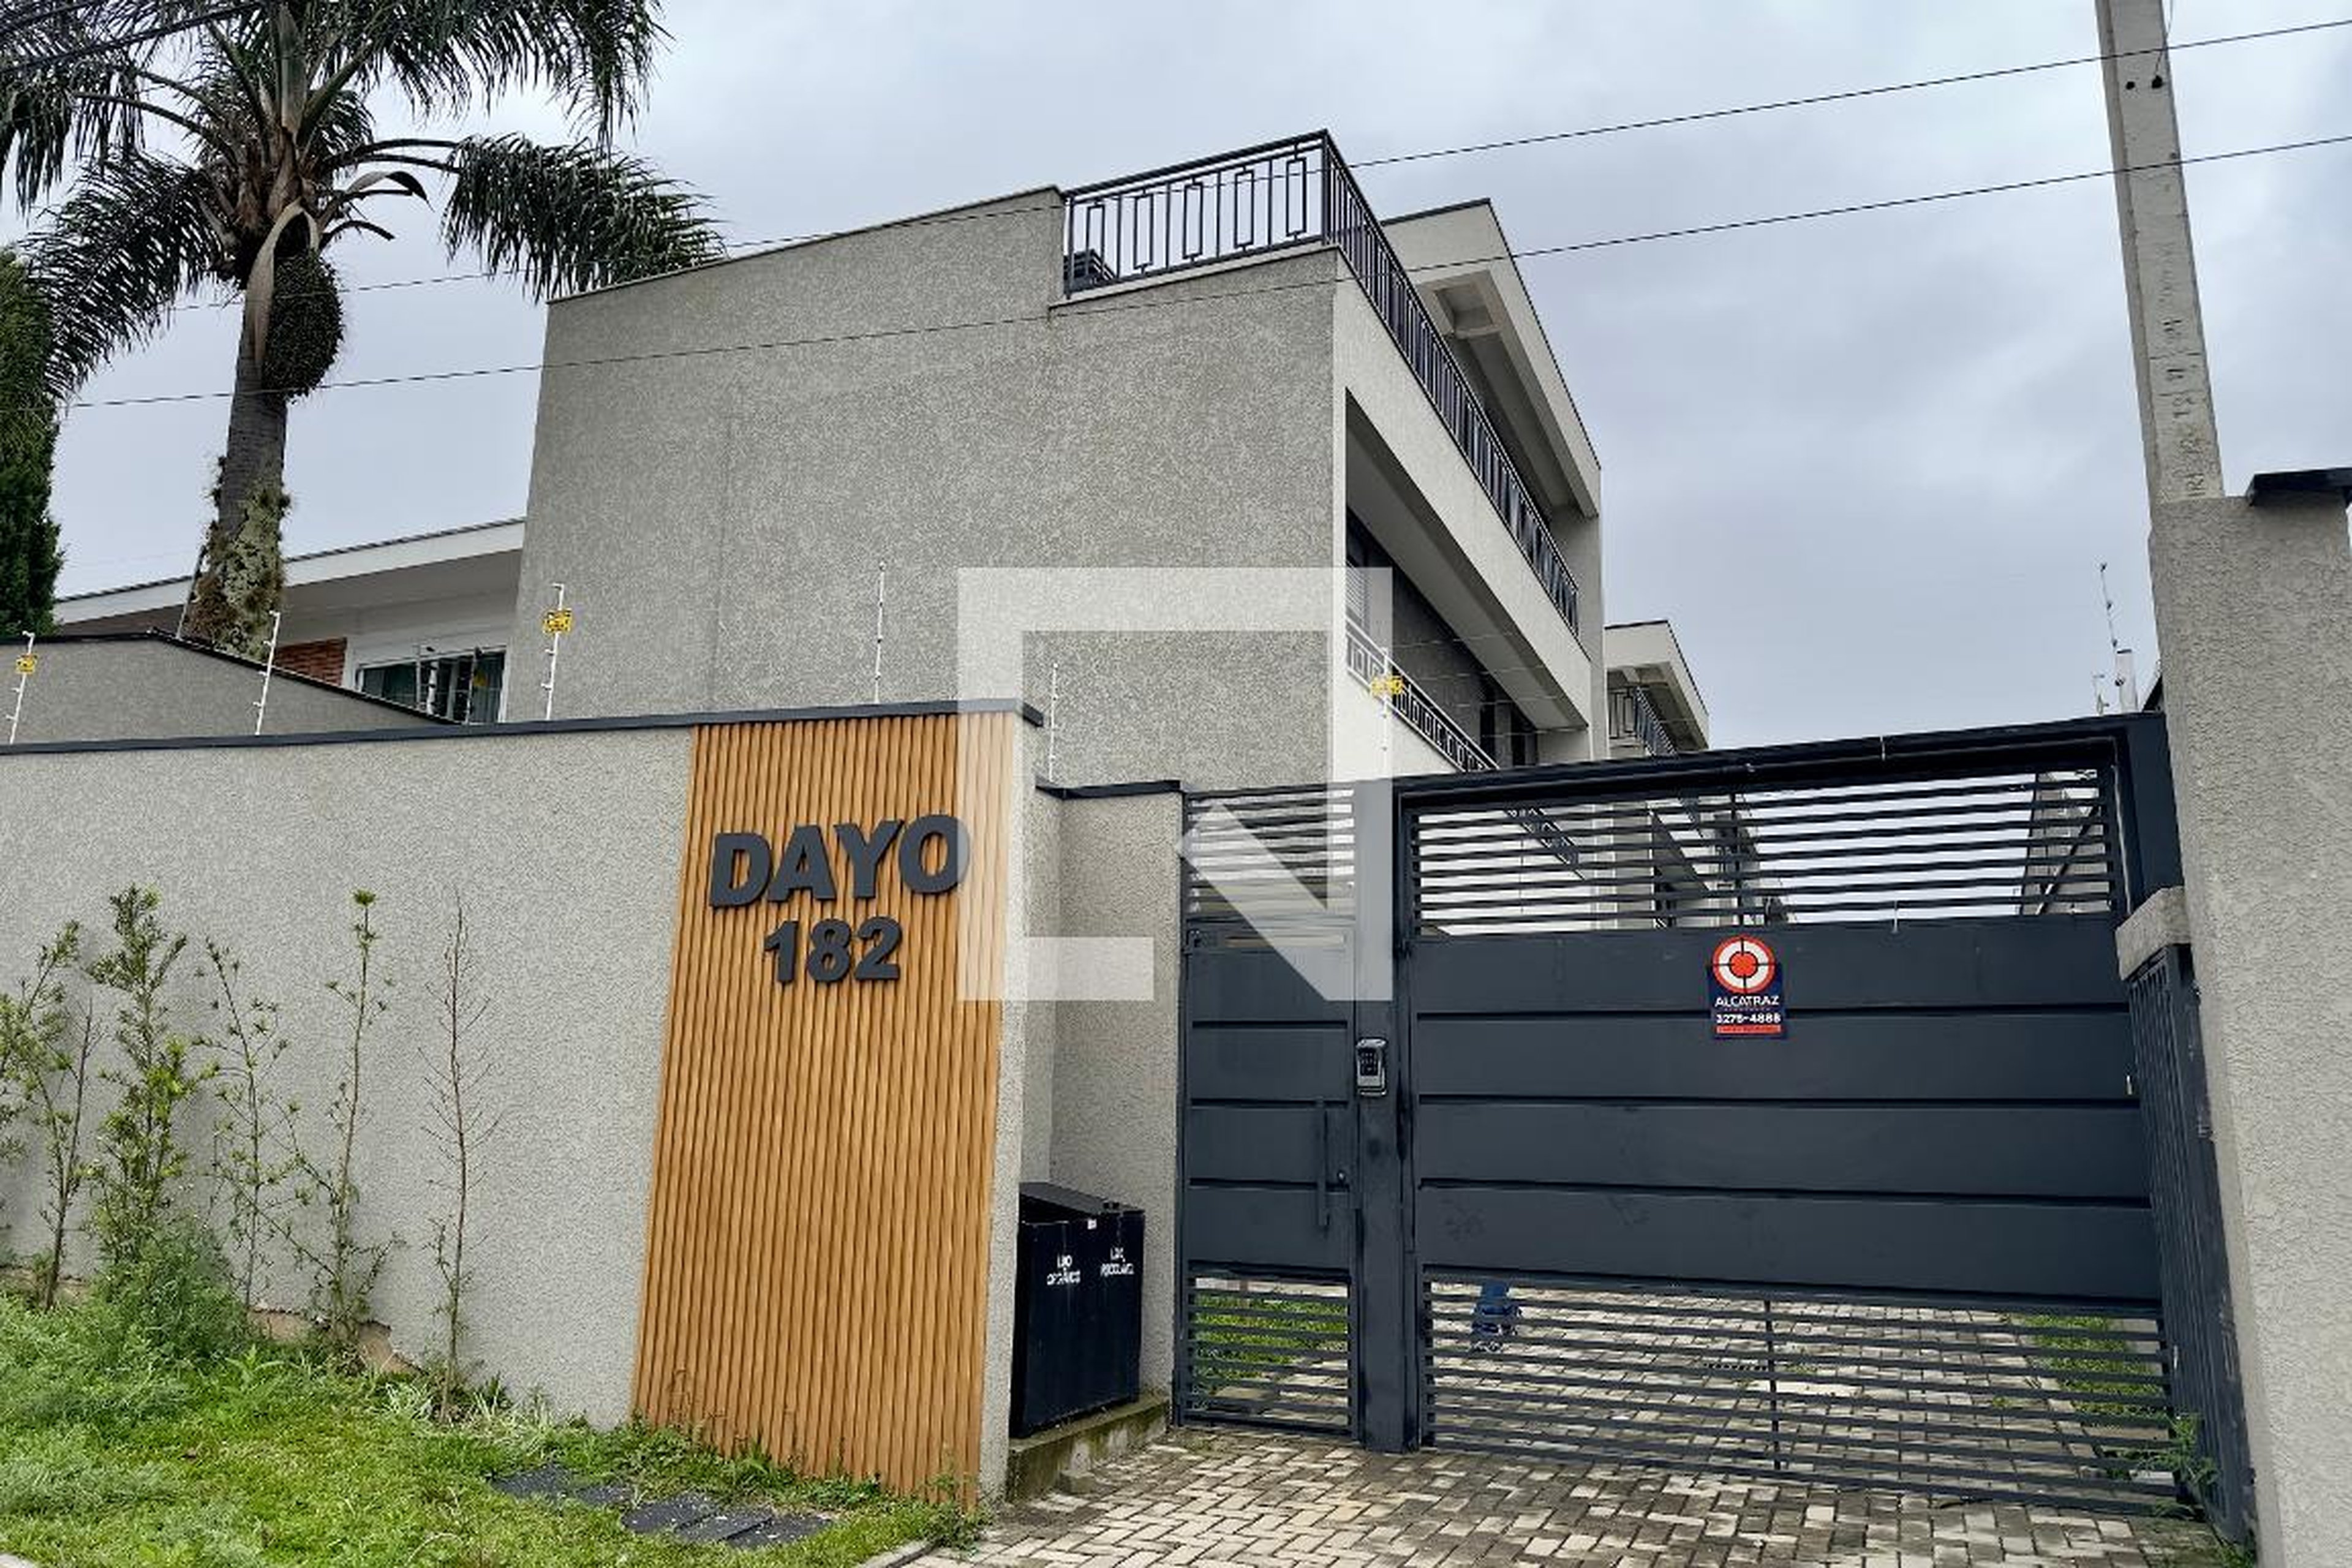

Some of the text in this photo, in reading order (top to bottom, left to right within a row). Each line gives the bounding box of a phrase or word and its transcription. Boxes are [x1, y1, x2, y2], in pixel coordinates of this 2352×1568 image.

[709, 813, 971, 909] DAYO
[763, 916, 903, 984] 182
[1715, 995, 1779, 1008] ALCATRAZ
